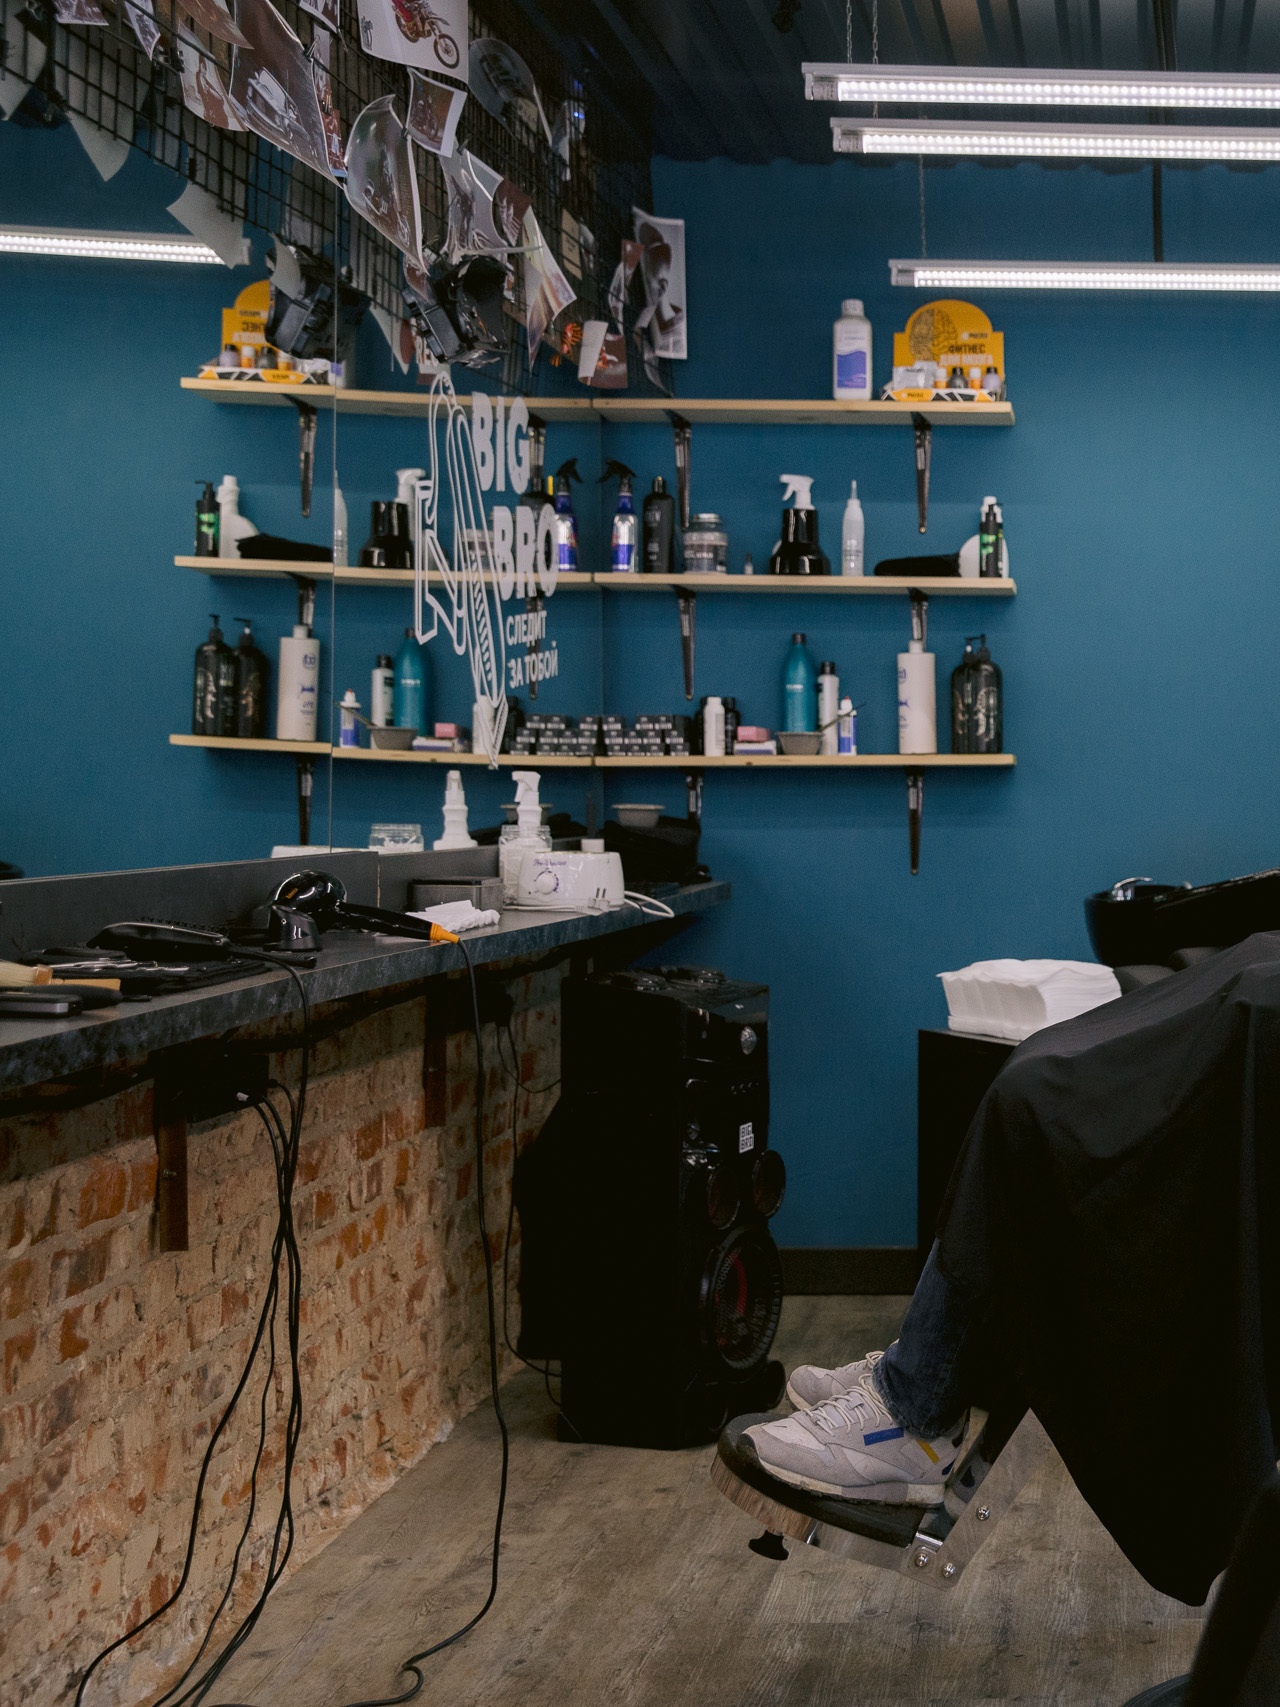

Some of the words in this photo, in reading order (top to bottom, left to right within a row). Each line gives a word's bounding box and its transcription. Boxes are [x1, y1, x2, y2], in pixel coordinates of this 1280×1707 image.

[949, 344, 985, 354] ФИТНЕС
[472, 391, 530, 494] BIG
[492, 502, 560, 601] BRO
[506, 610, 547, 647] СЛЕДИТ
[508, 655, 525, 689] ЗА
[525, 641, 559, 684] ТОБОЙ
[741, 1124, 752, 1138] BIG
[741, 1136, 753, 1149] BRO
